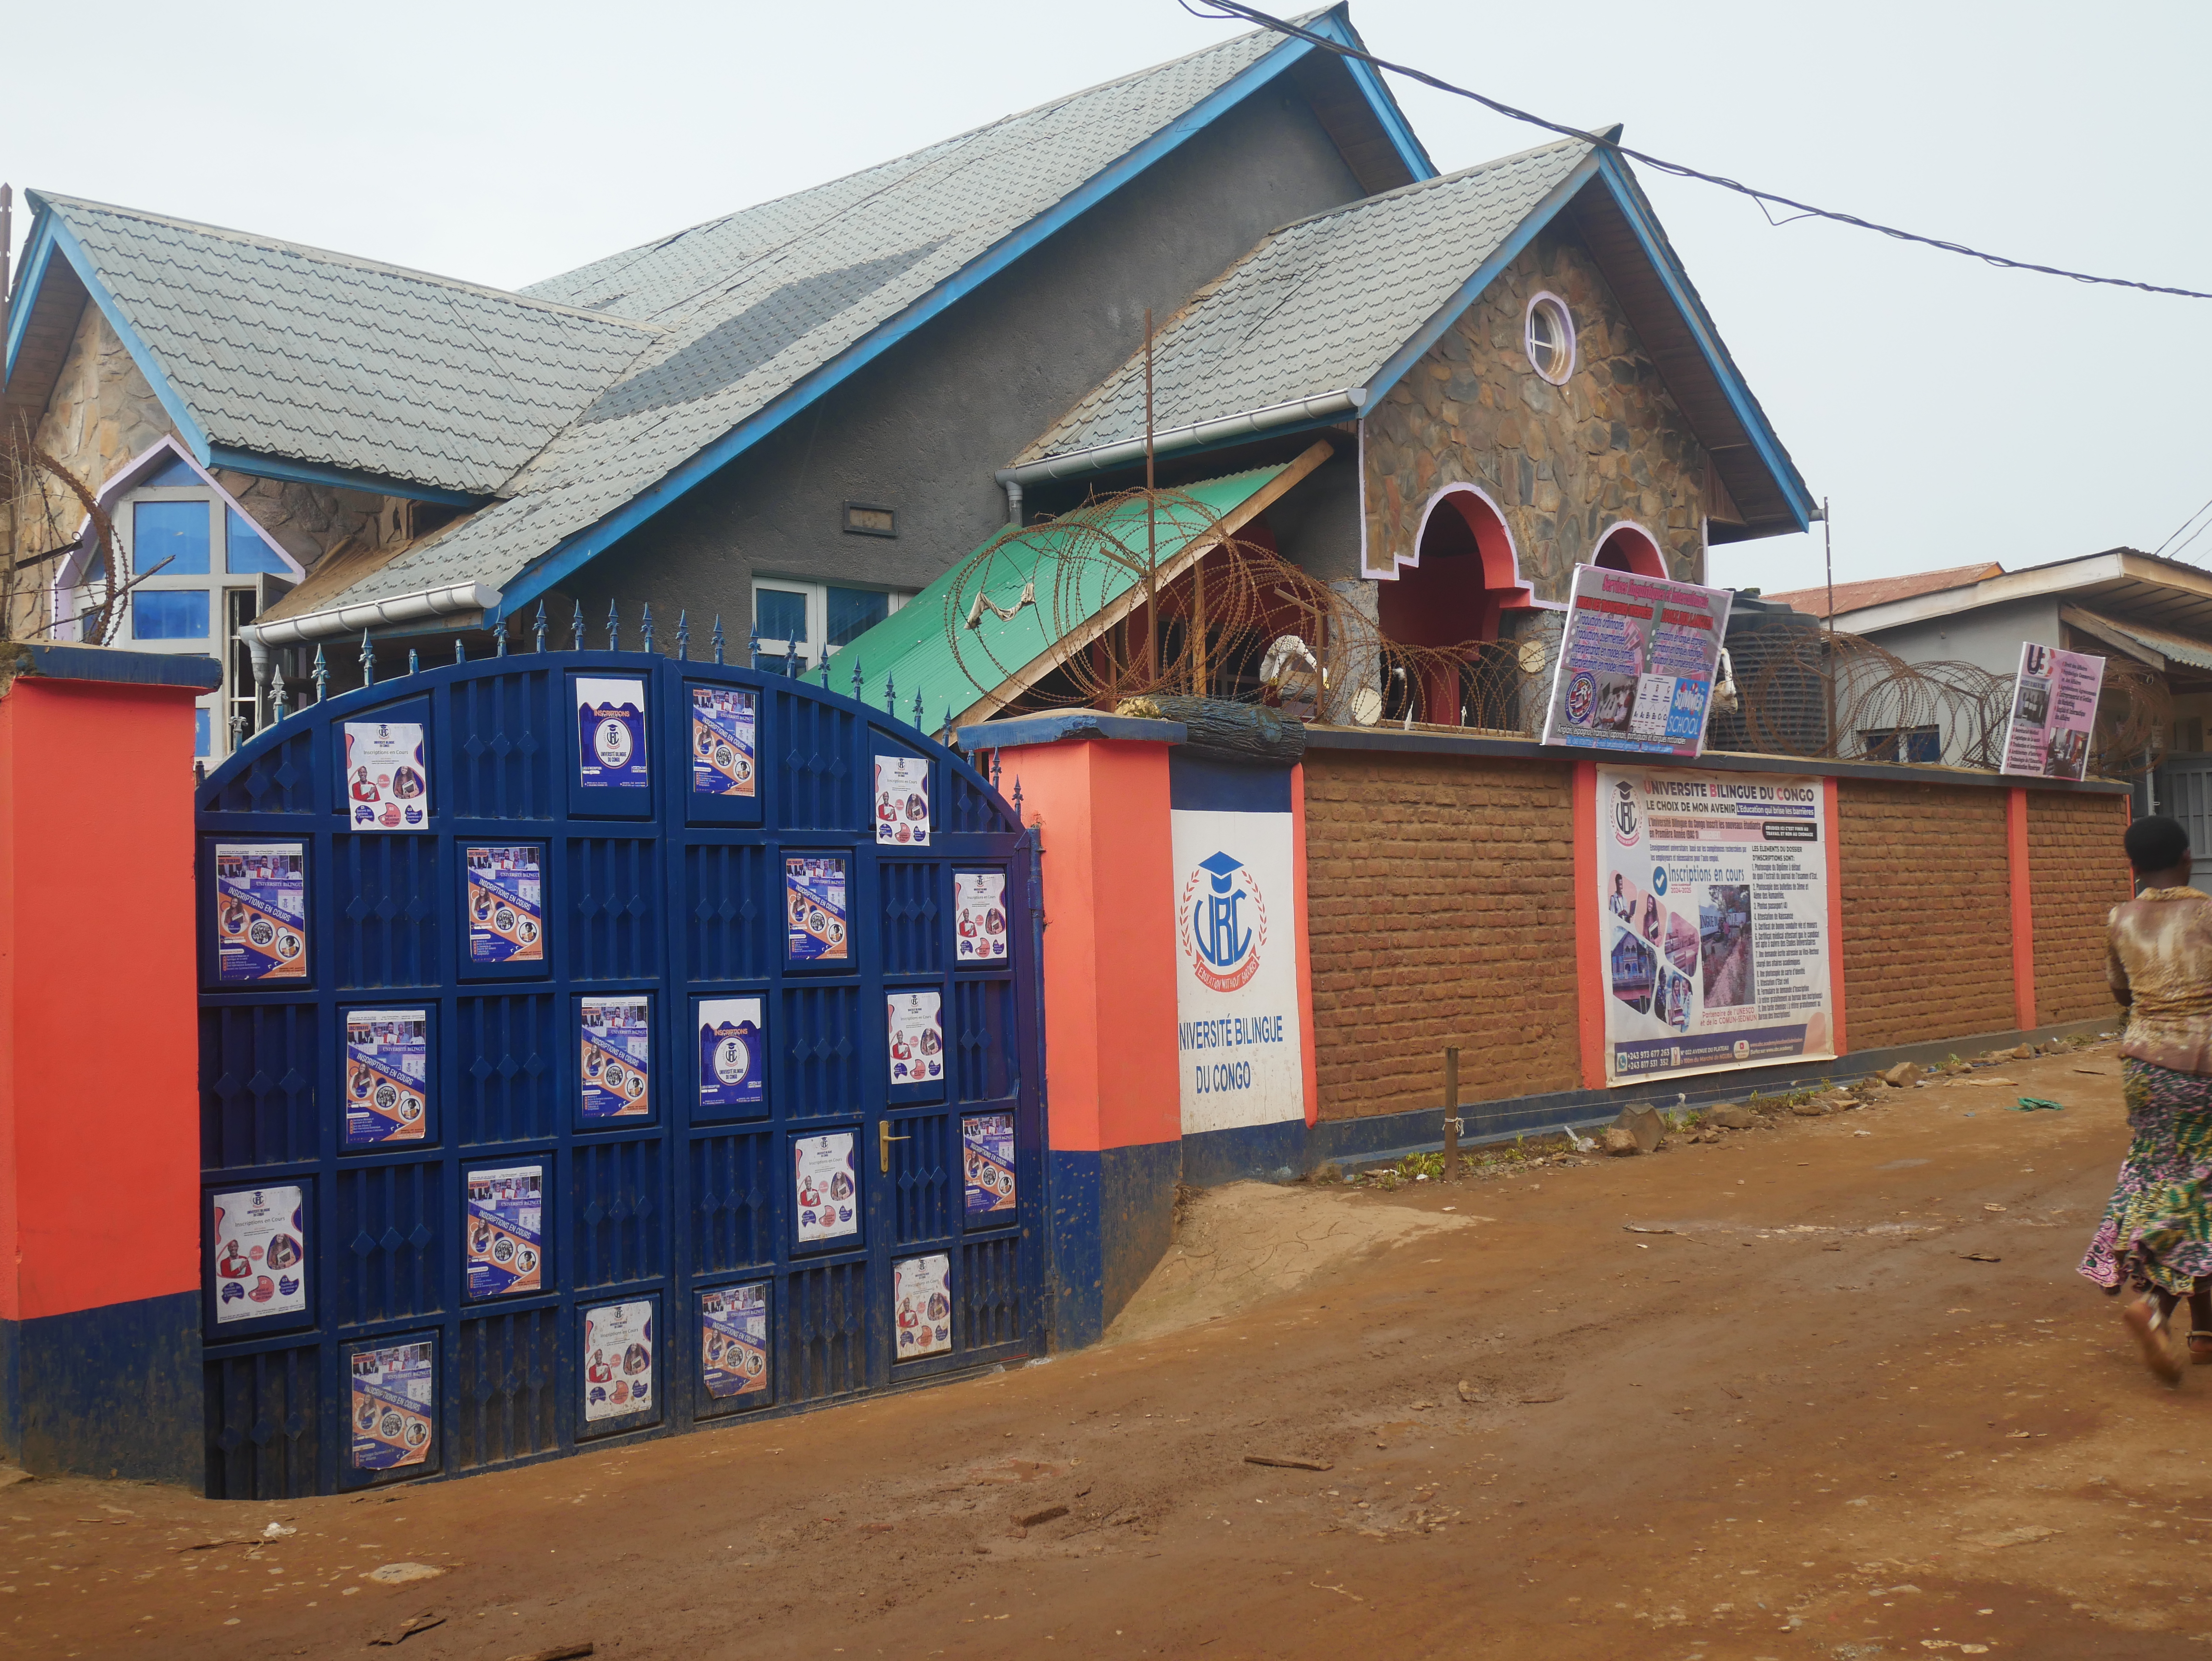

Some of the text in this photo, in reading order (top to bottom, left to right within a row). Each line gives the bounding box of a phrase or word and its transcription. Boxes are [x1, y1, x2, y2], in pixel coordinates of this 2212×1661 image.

[1602, 574, 1628, 594] Services
[1579, 611, 1602, 627] Traductions
[1575, 626, 1599, 641] Traductions
[1675, 689, 1704, 712] SUMMER
[702, 716, 746, 751] INSCRIPTIONS EN COURS
[1667, 715, 1698, 735] SCHOOL
[607, 732, 619, 745] UBC
[1644, 780, 1814, 802] UNIVERSITE BILINGUE DU CONGO
[1616, 801, 1637, 834] UBC
[1646, 800, 1736, 814] LE CHOIX DE MON AVENIR
[1737, 805, 1764, 813] L'Education
[1764, 806, 1773, 815] qui
[1773, 806, 1785, 814] brise
[1688, 819, 1693, 828] du
[1694, 819, 1705, 829] Congo
[1669, 863, 1745, 885] Inscriptions en cours
[228, 886, 291, 922] INSCRIPTIONS EN COURS
[479, 878, 531, 910] INSCRIPTIONS EN COURS
[1194, 889, 1252, 967] UBC
[1198, 966, 1221, 990] EDUCATION
[1221, 974, 1241, 990] WITHOUT
[1702, 1010, 1726, 1018] Partenaire
[1719, 1014, 1757, 1025] COMUN-SEDMUN
[1235, 1015, 1283, 1045] BILINGUE
[591, 1036, 639, 1066] INSCRIPTIONS EN COURS
[726, 1050, 737, 1062] UBC
[1627, 1051, 1639, 1060] +243
[1640, 1050, 1649, 1058] 973
[1651, 1049, 1660, 1058] 677
[356, 1053, 413, 1085] INSCRIPTIONS EN COURS
[1628, 1061, 1639, 1069] +243
[1641, 1060, 1649, 1068] 817
[1660, 1058, 1669, 1067] 352
[1196, 1061, 1251, 1094] DU CONGO
[478, 1210, 531, 1239] INSCRIPTIONS EN COURS
[364, 1384, 421, 1411] INSCRIPTIONS EN COURS
